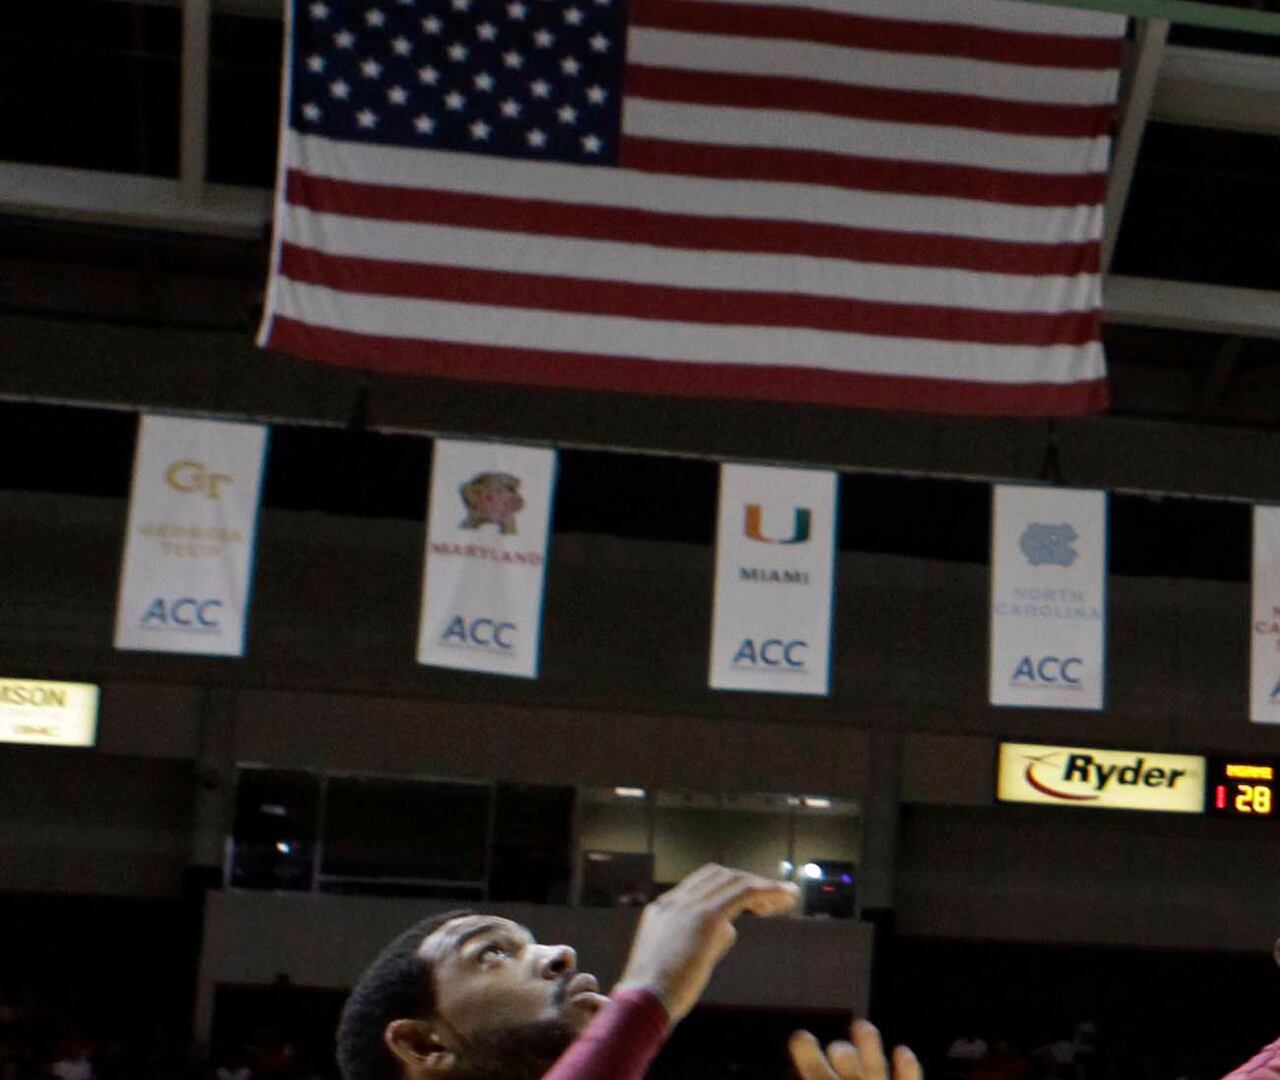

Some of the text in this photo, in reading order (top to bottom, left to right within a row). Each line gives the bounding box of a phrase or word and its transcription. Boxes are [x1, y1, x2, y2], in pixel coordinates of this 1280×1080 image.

[432, 543, 545, 566] MARYLAND
[740, 567, 810, 585] MIAMI
[1013, 586, 1085, 602] NORTH
[141, 598, 223, 626] ACC
[996, 602, 1101, 620] CAROLINA
[442, 614, 518, 649] ACC
[732, 638, 809, 666] ACC
[1012, 656, 1085, 684] ACC
[1062, 753, 1186, 790] Ryder
[1235, 784, 1271, 813] 28
